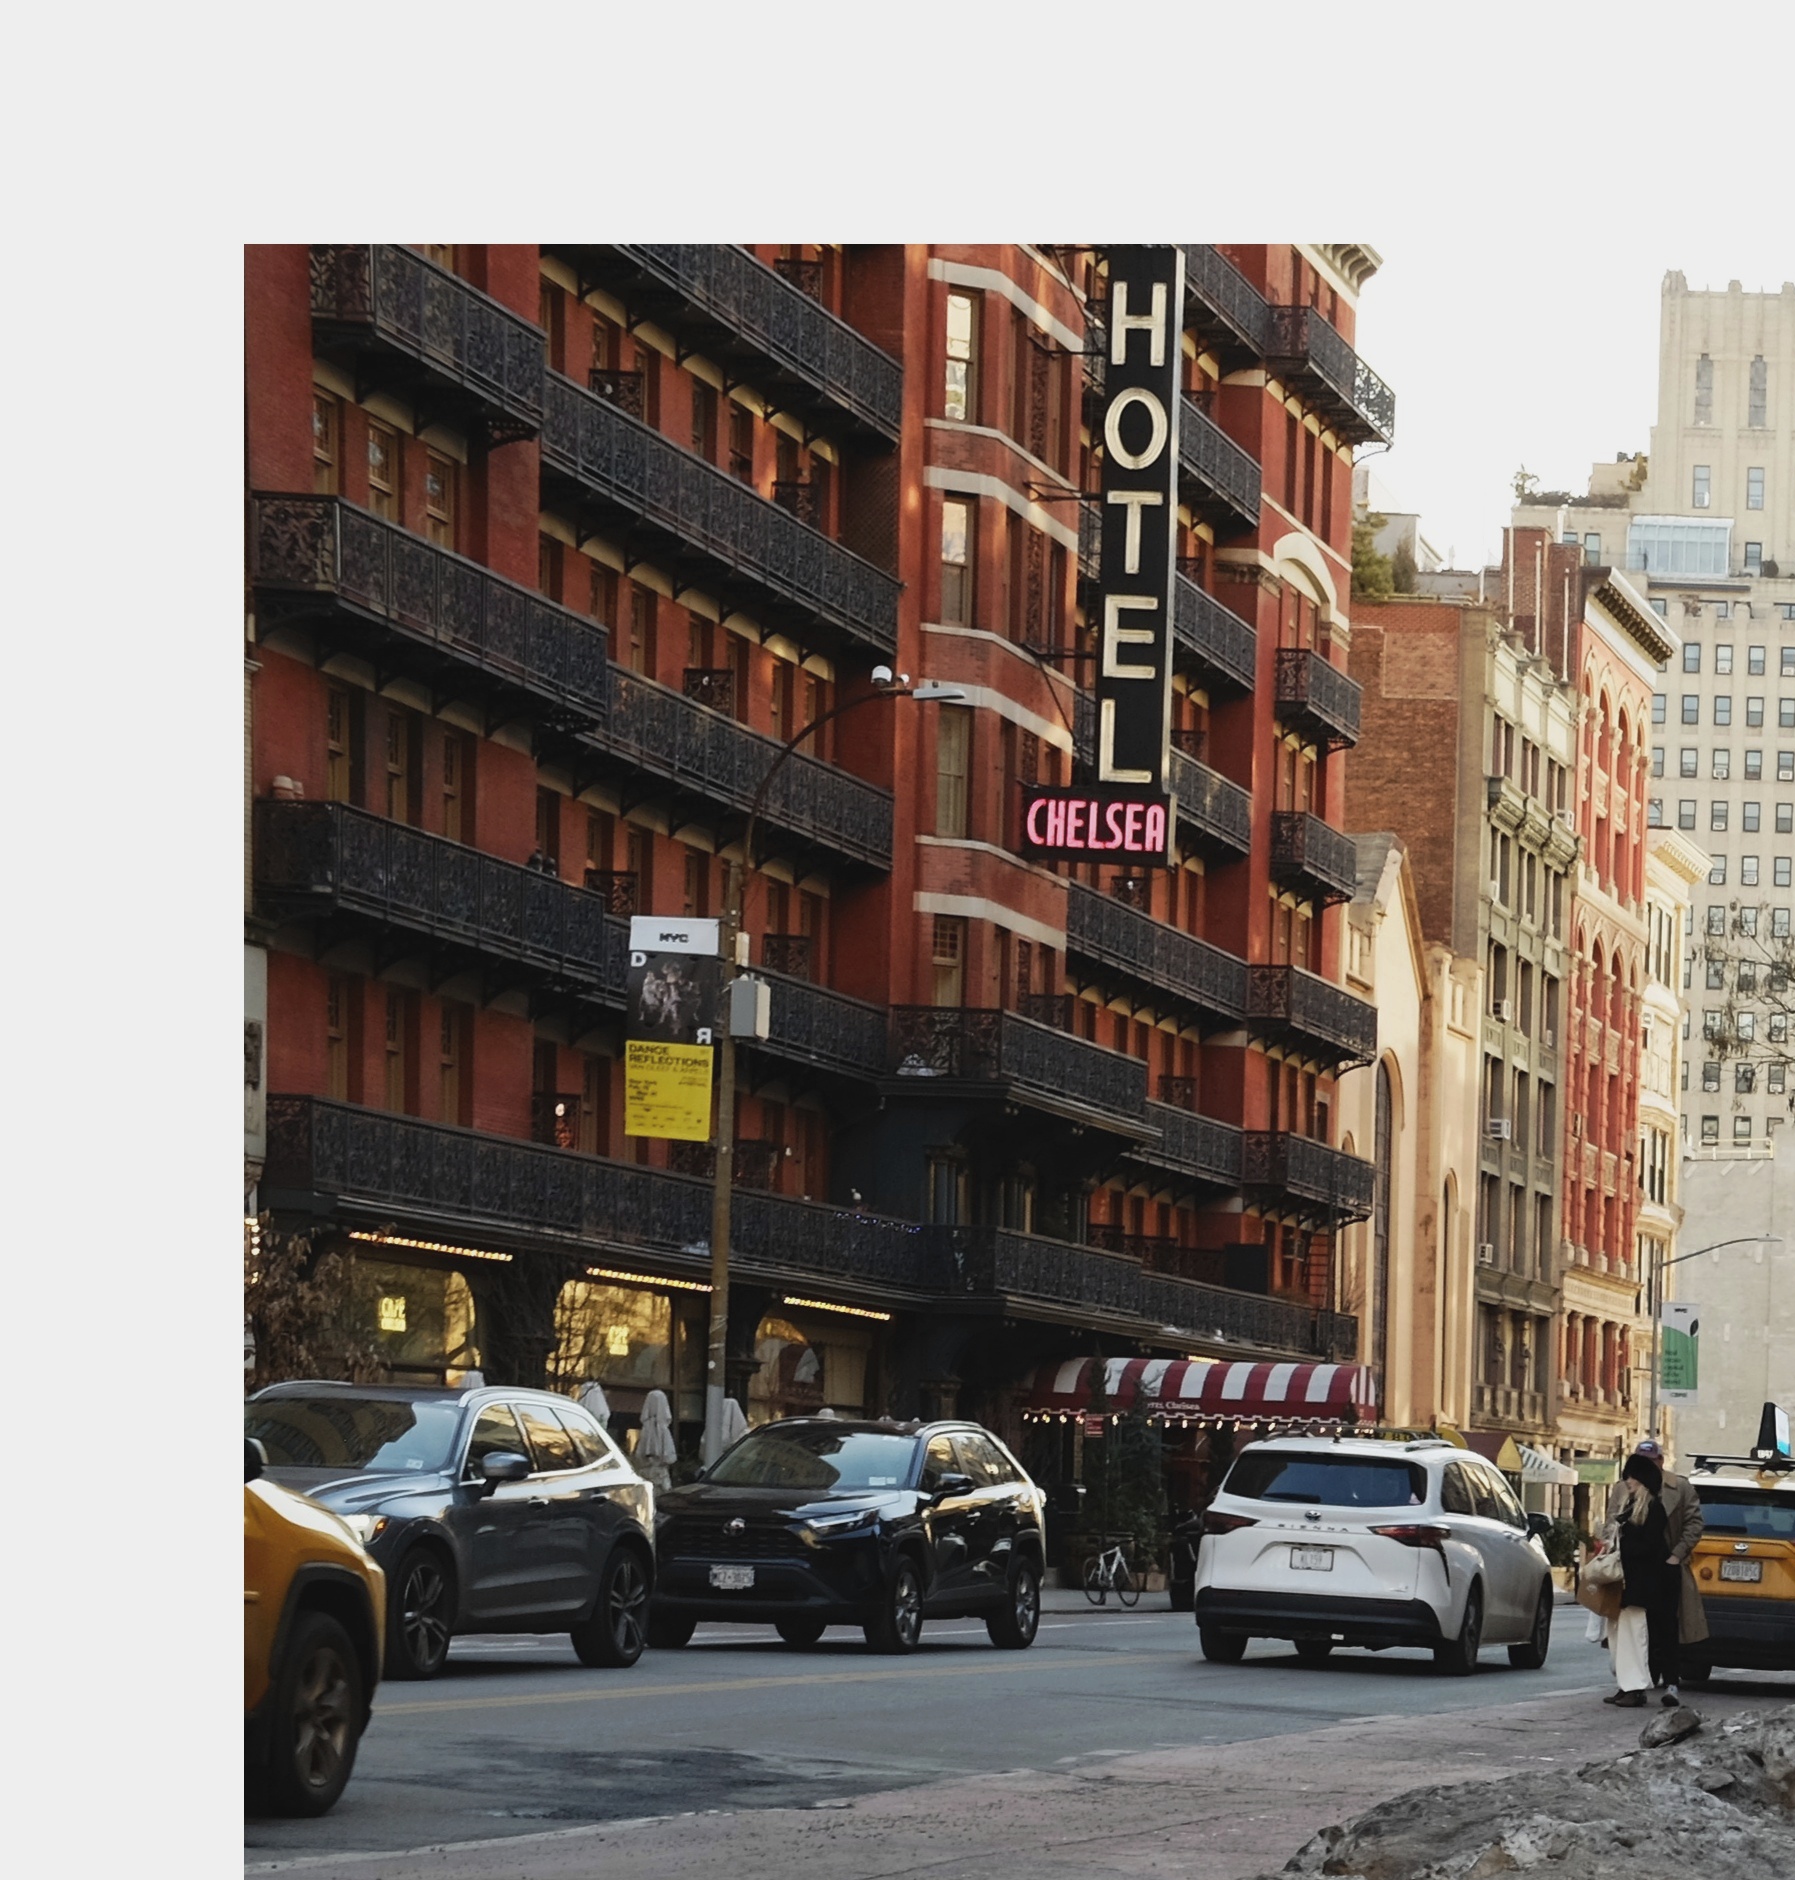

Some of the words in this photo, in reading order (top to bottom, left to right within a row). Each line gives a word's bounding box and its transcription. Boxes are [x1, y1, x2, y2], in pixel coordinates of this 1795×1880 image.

[1098, 281, 1168, 785] HOTEL
[1026, 798, 1165, 854] CHELSEA
[659, 933, 688, 943] NYC
[631, 952, 647, 967] D
[629, 1044, 668, 1055] DANCE
[629, 1054, 709, 1068] REFLECTIONS
